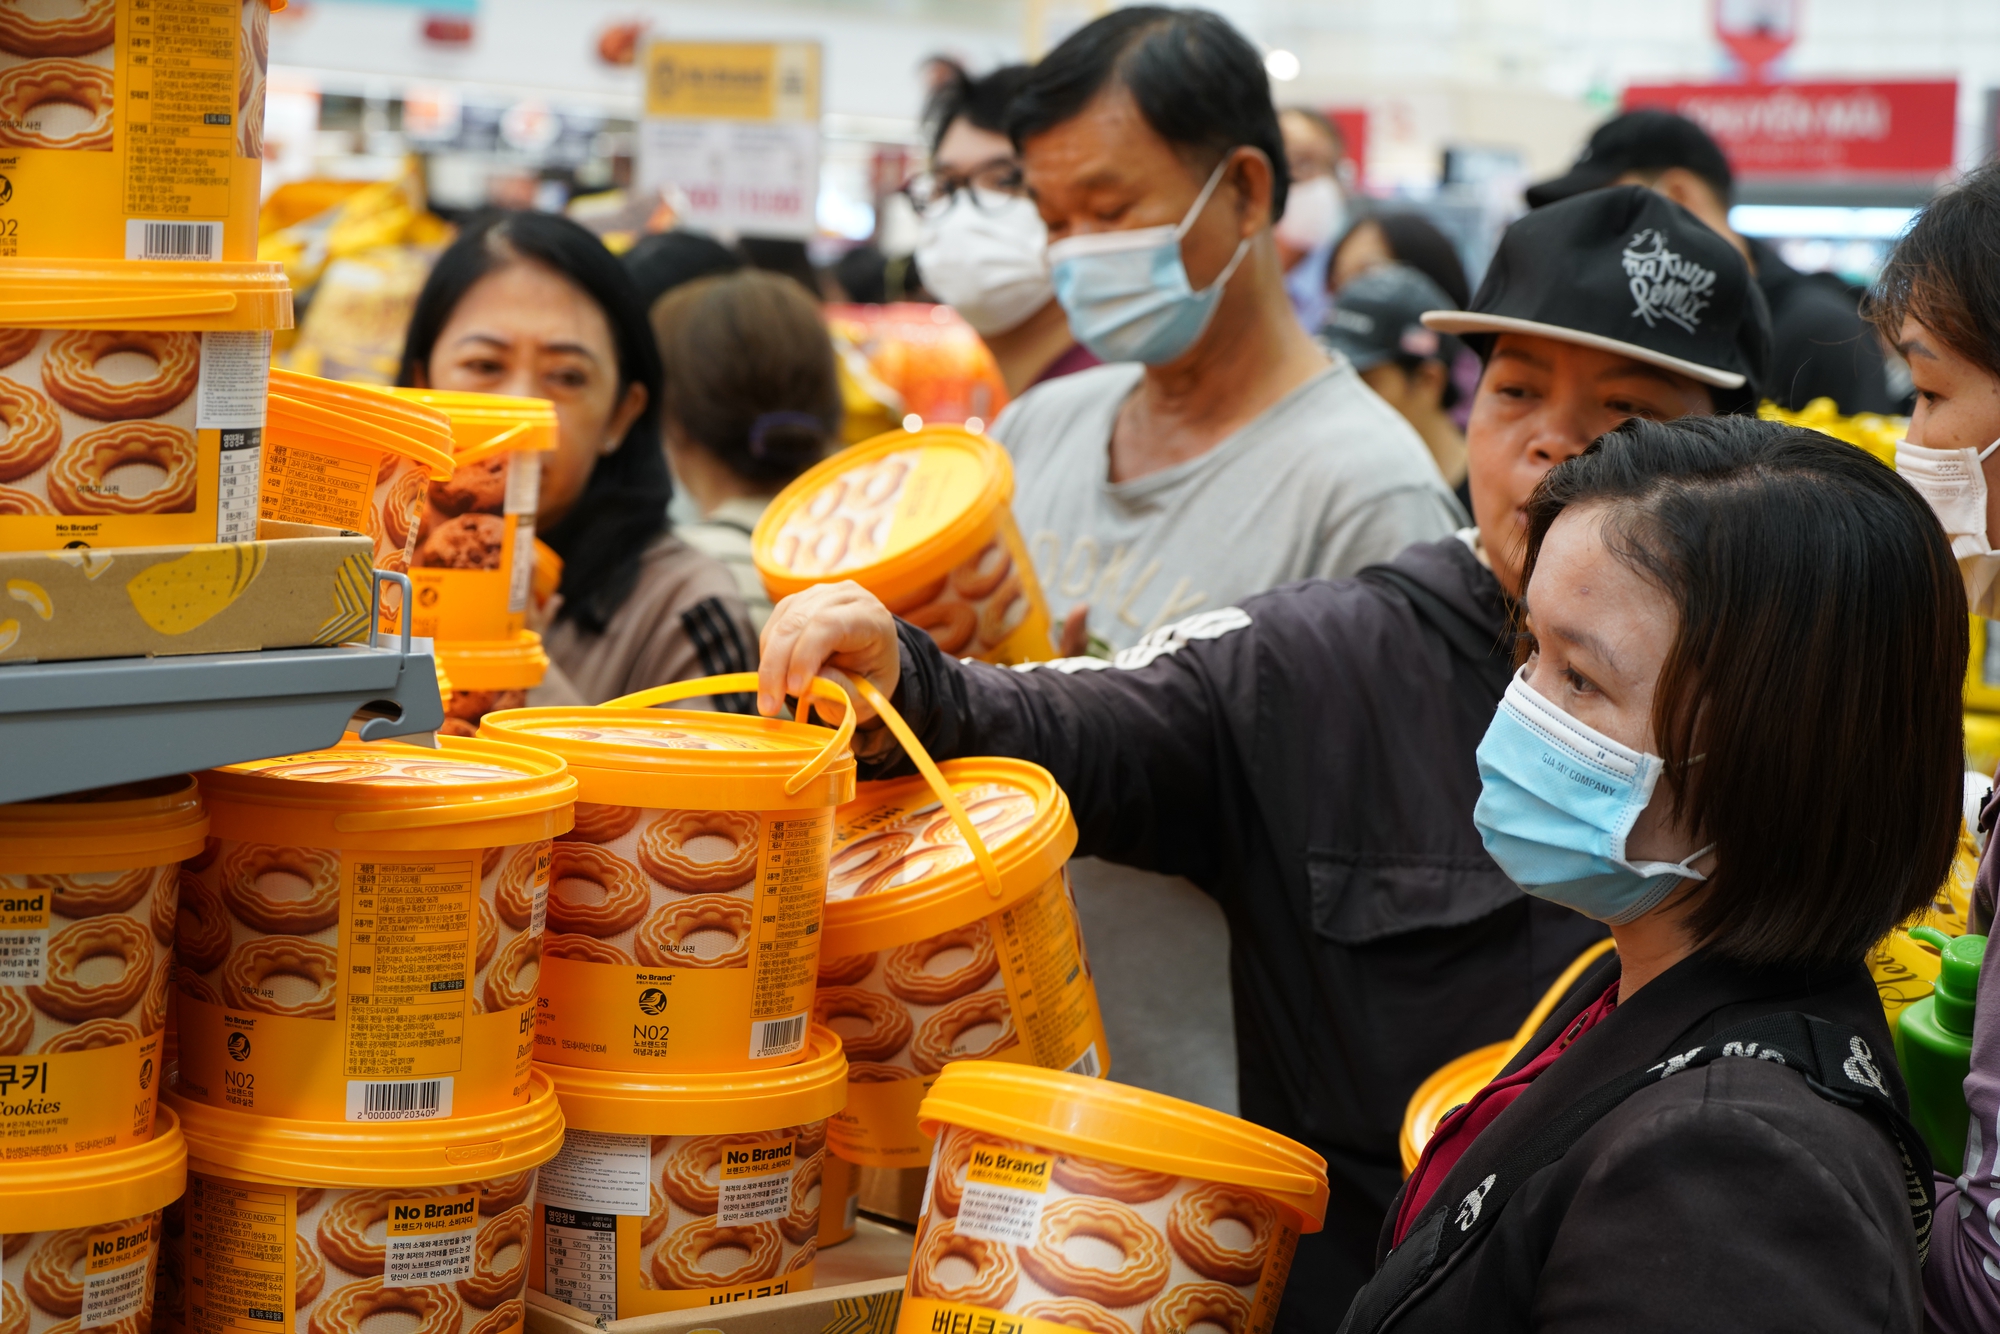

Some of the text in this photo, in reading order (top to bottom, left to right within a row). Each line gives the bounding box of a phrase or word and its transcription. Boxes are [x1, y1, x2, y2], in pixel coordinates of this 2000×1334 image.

[71, 523, 98, 531] Brand
[1541, 752, 1616, 797] GIA MY COMPANY
[440, 884, 463, 892] INDUSTRY
[659, 944, 695, 954] 이미지 사진
[241, 985, 274, 998] 이미지 사진
[224, 1015, 254, 1026] No Brand
[562, 1039, 607, 1054] 인도네시아산 (OEM)
[634, 1041, 667, 1049] 노브랜드의
[226, 1086, 253, 1099] 노브랜드의
[368, 1111, 401, 1120] 000000
[404, 1109, 436, 1119] 203409
[462, 1147, 493, 1159] OPEN
[727, 1142, 792, 1164] No Brand
[726, 1166, 750, 1175] 브랜드가
[771, 1159, 790, 1169] 소비자다
[974, 1150, 1047, 1176] No Brand
[395, 1206, 420, 1220] No
[424, 1198, 474, 1218] Brand
[741, 1201, 765, 1210] 노브랜드의
[239, 1212, 252, 1220] FOOD
[253, 1214, 276, 1223] INDUSTRY
[394, 1216, 473, 1231] 브랜드가 아니다. 소비자다
[548, 1210, 576, 1225] 영양정보
[93, 1225, 149, 1257] No Brand
[393, 1242, 411, 1250] 최적의
[413, 1240, 431, 1249] 소재와
[432, 1237, 459, 1247] 제조방법을
[582, 1243, 590, 1251] mg
[406, 1252, 423, 1260] 최저의
[426, 1249, 447, 1258] 가격대를
[449, 1247, 464, 1255] 만드는
[465, 1245, 470, 1253] 것
[412, 1260, 441, 1269] 노브랜드의
[443, 1258, 458, 1266] 이념과
[391, 1273, 408, 1281] 당신이
[410, 1271, 428, 1280] 스마트
[430, 1269, 451, 1278] 컨슈머가
[453, 1267, 463, 1275] 되는
